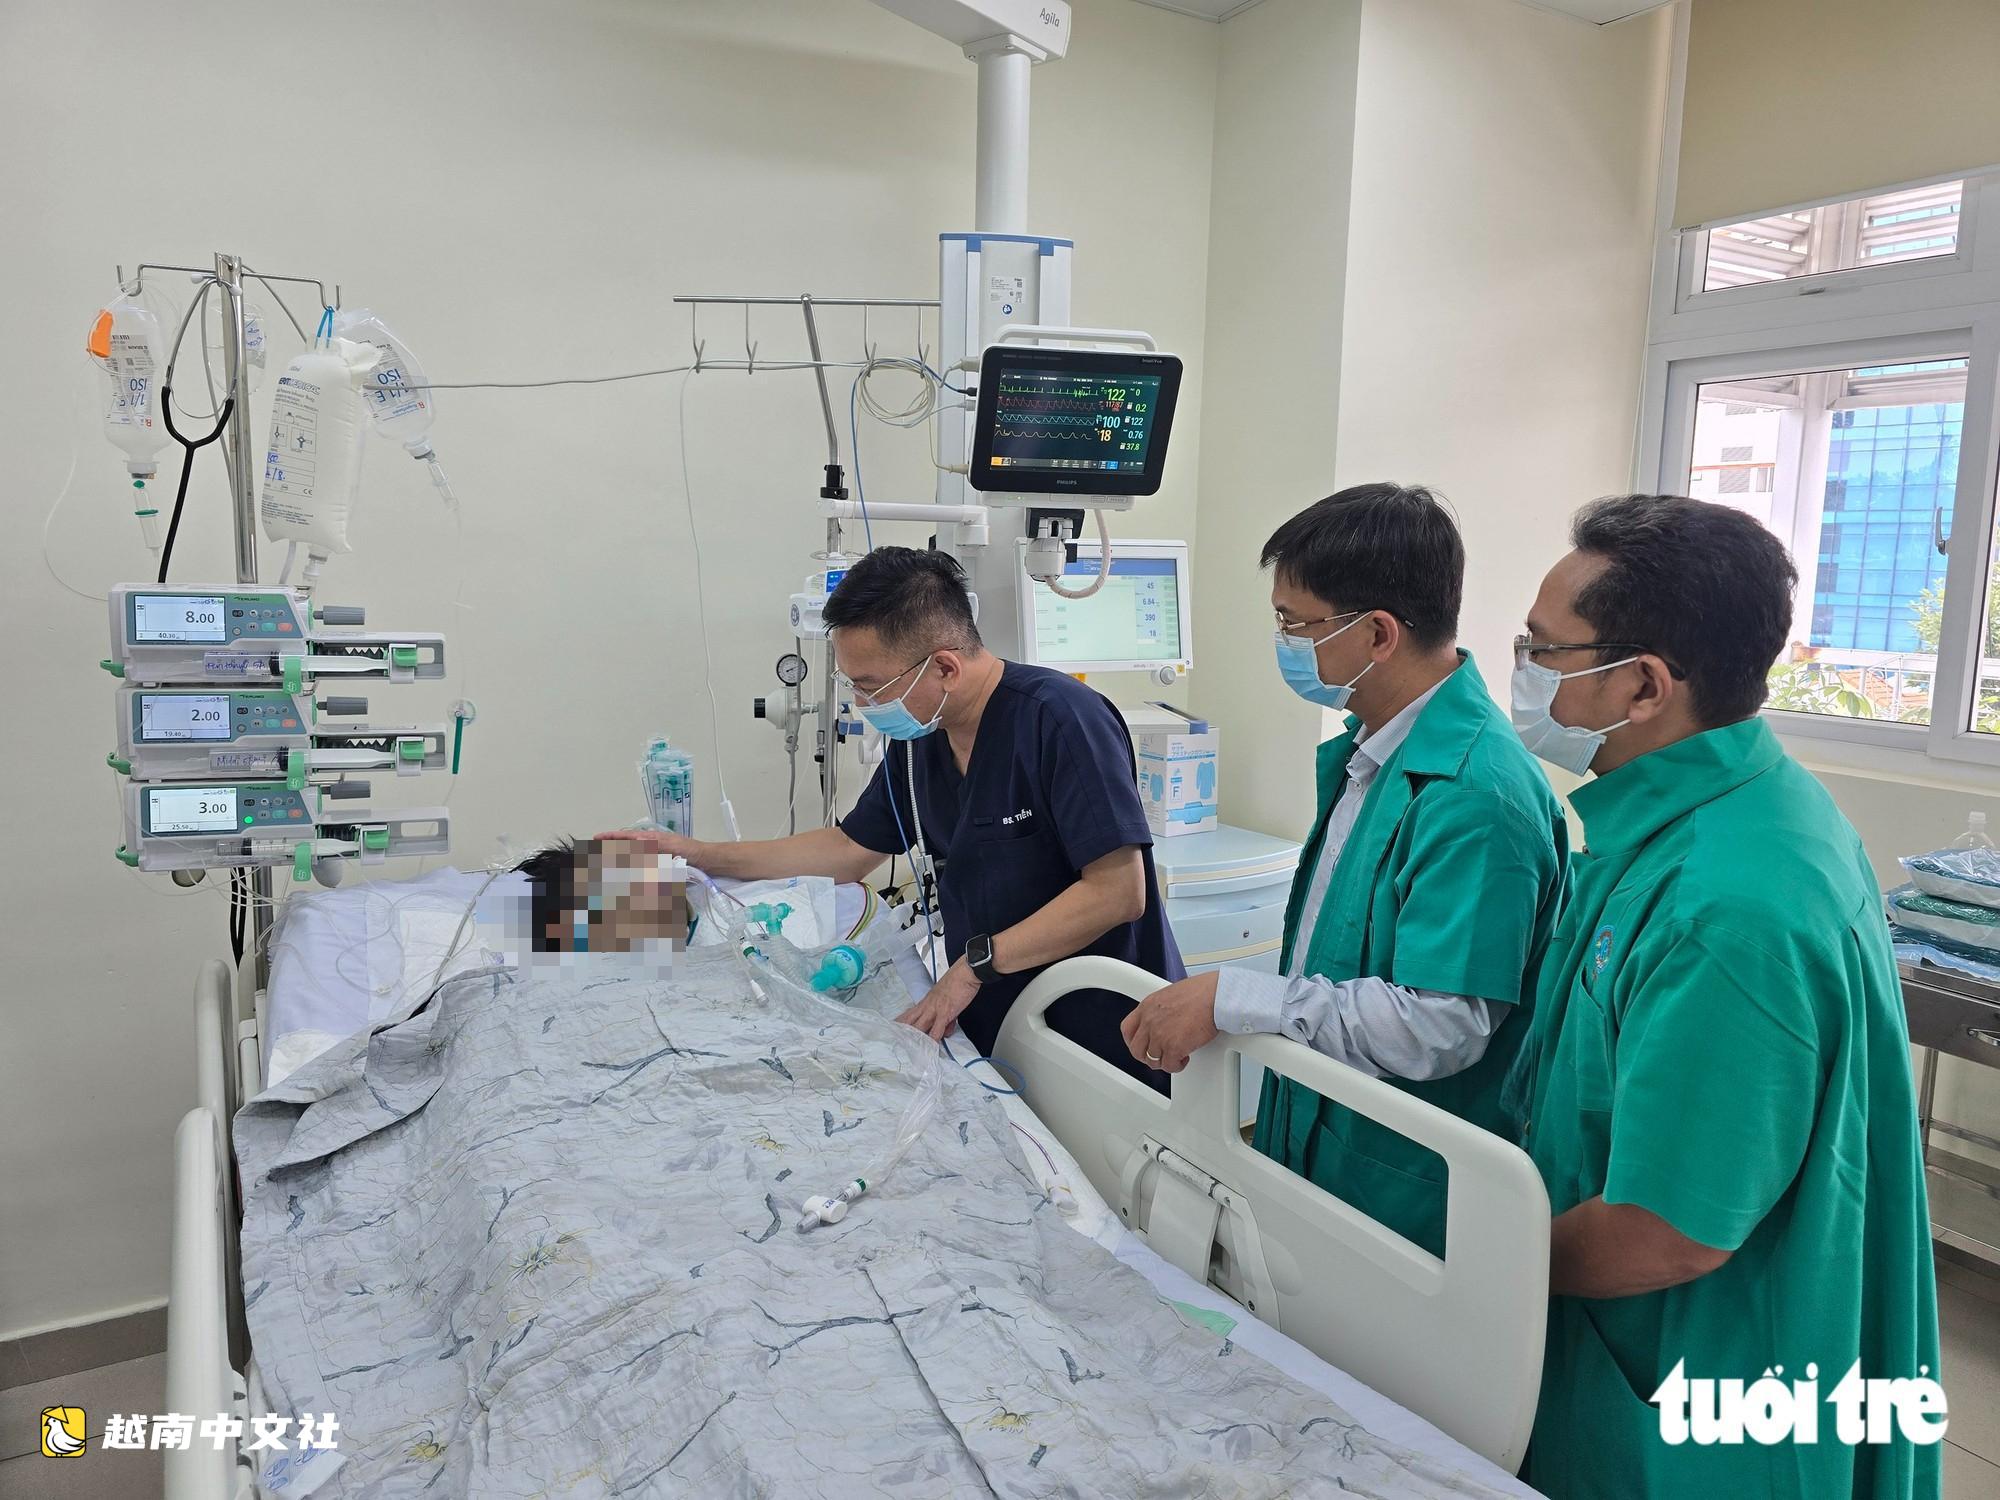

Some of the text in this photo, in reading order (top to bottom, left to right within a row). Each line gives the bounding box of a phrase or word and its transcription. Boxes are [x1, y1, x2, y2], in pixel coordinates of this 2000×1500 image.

[1039, 7, 1060, 27] Agila
[377, 368, 401, 385] ISO
[129, 378, 147, 391] ISO
[375, 390, 386, 403] E
[1108, 388, 1126, 401] 122
[1135, 403, 1147, 412] 0.2
[1102, 415, 1144, 428] 100 122
[1099, 429, 1144, 442] 18 0.76
[1125, 442, 1140, 450] 37.8
[185, 611, 215, 624] 8.00
[191, 709, 220, 721] 2.00
[1173, 785, 1180, 797] F
[199, 801, 227, 814] 3.00
